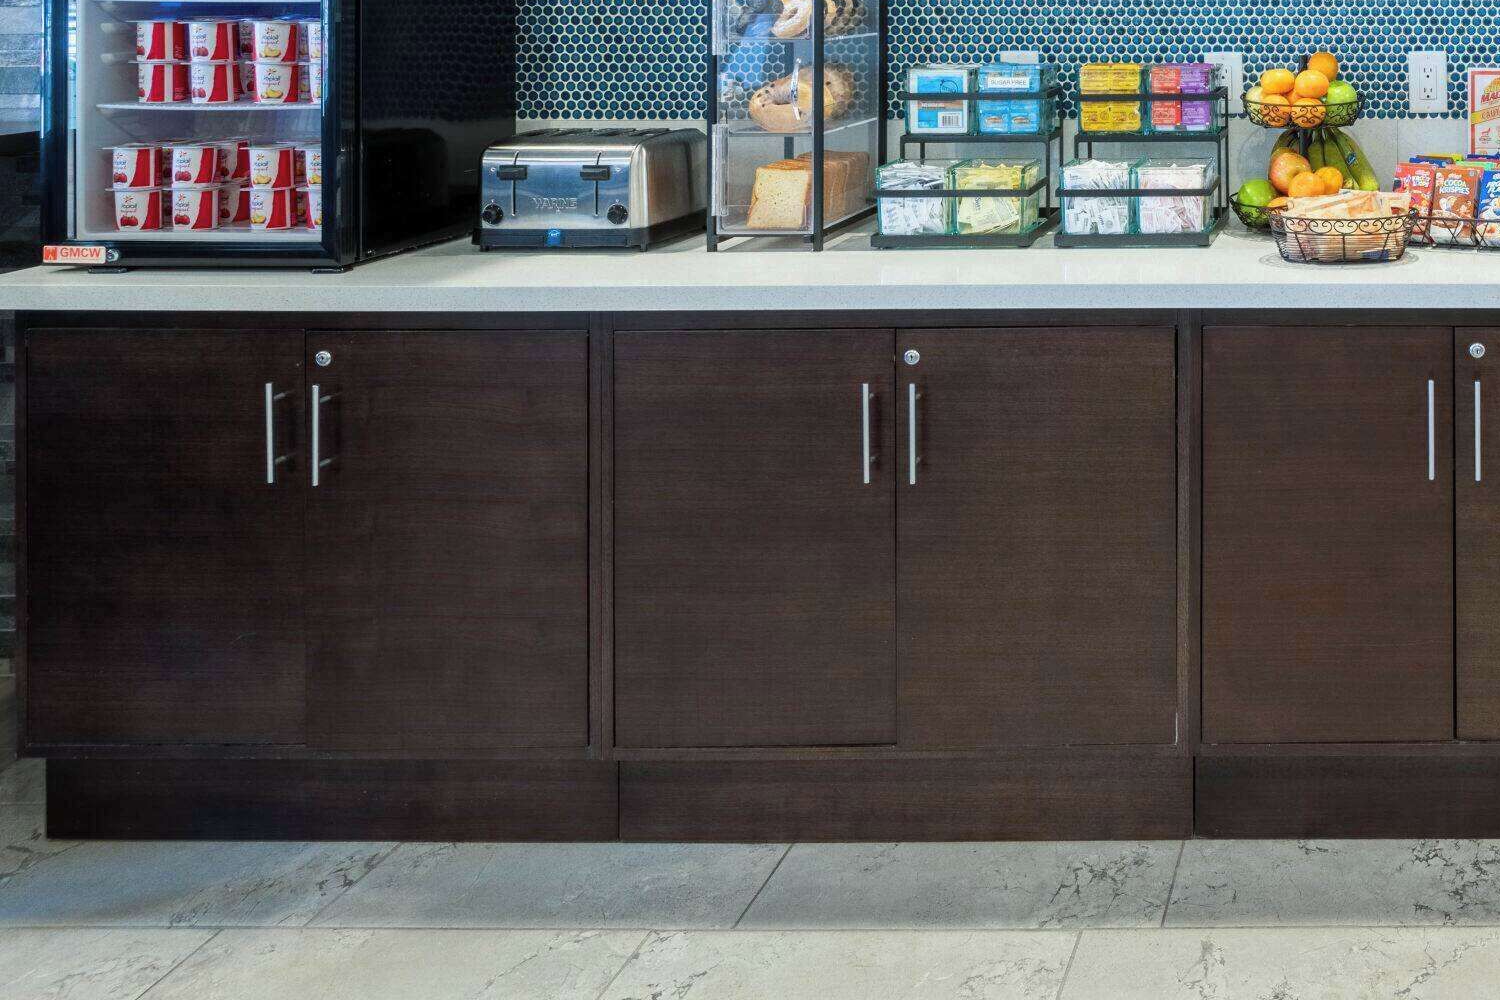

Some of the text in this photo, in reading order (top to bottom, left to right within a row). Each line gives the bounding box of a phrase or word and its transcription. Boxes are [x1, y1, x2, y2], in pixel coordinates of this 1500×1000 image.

[1444, 179, 1467, 187] COCOA
[1439, 186, 1470, 195] KRISPIES
[61, 247, 101, 258] GMCW
